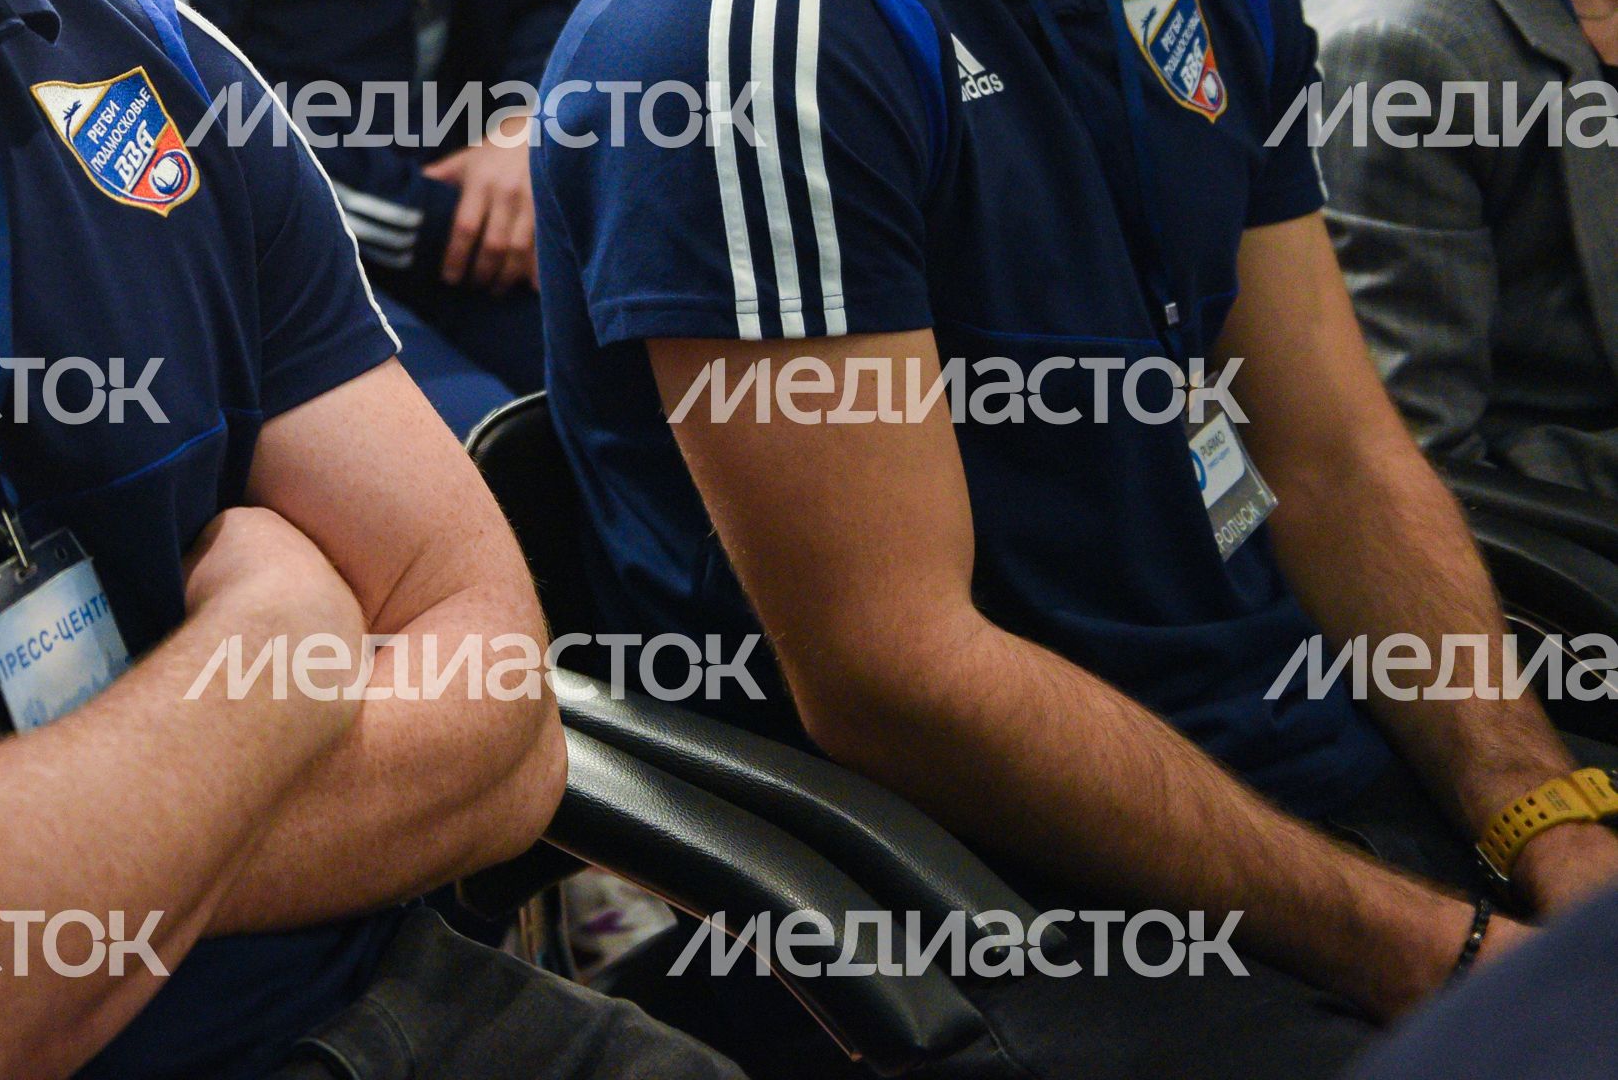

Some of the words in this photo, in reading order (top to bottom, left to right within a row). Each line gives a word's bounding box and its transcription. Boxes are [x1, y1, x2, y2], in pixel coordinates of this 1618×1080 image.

[961, 73, 1004, 103] idas
[86, 99, 121, 144] РЕГБИ
[90, 87, 151, 173] ПОДМОСКОВЬЕ
[1214, 500, 1261, 554] РОПУСК
